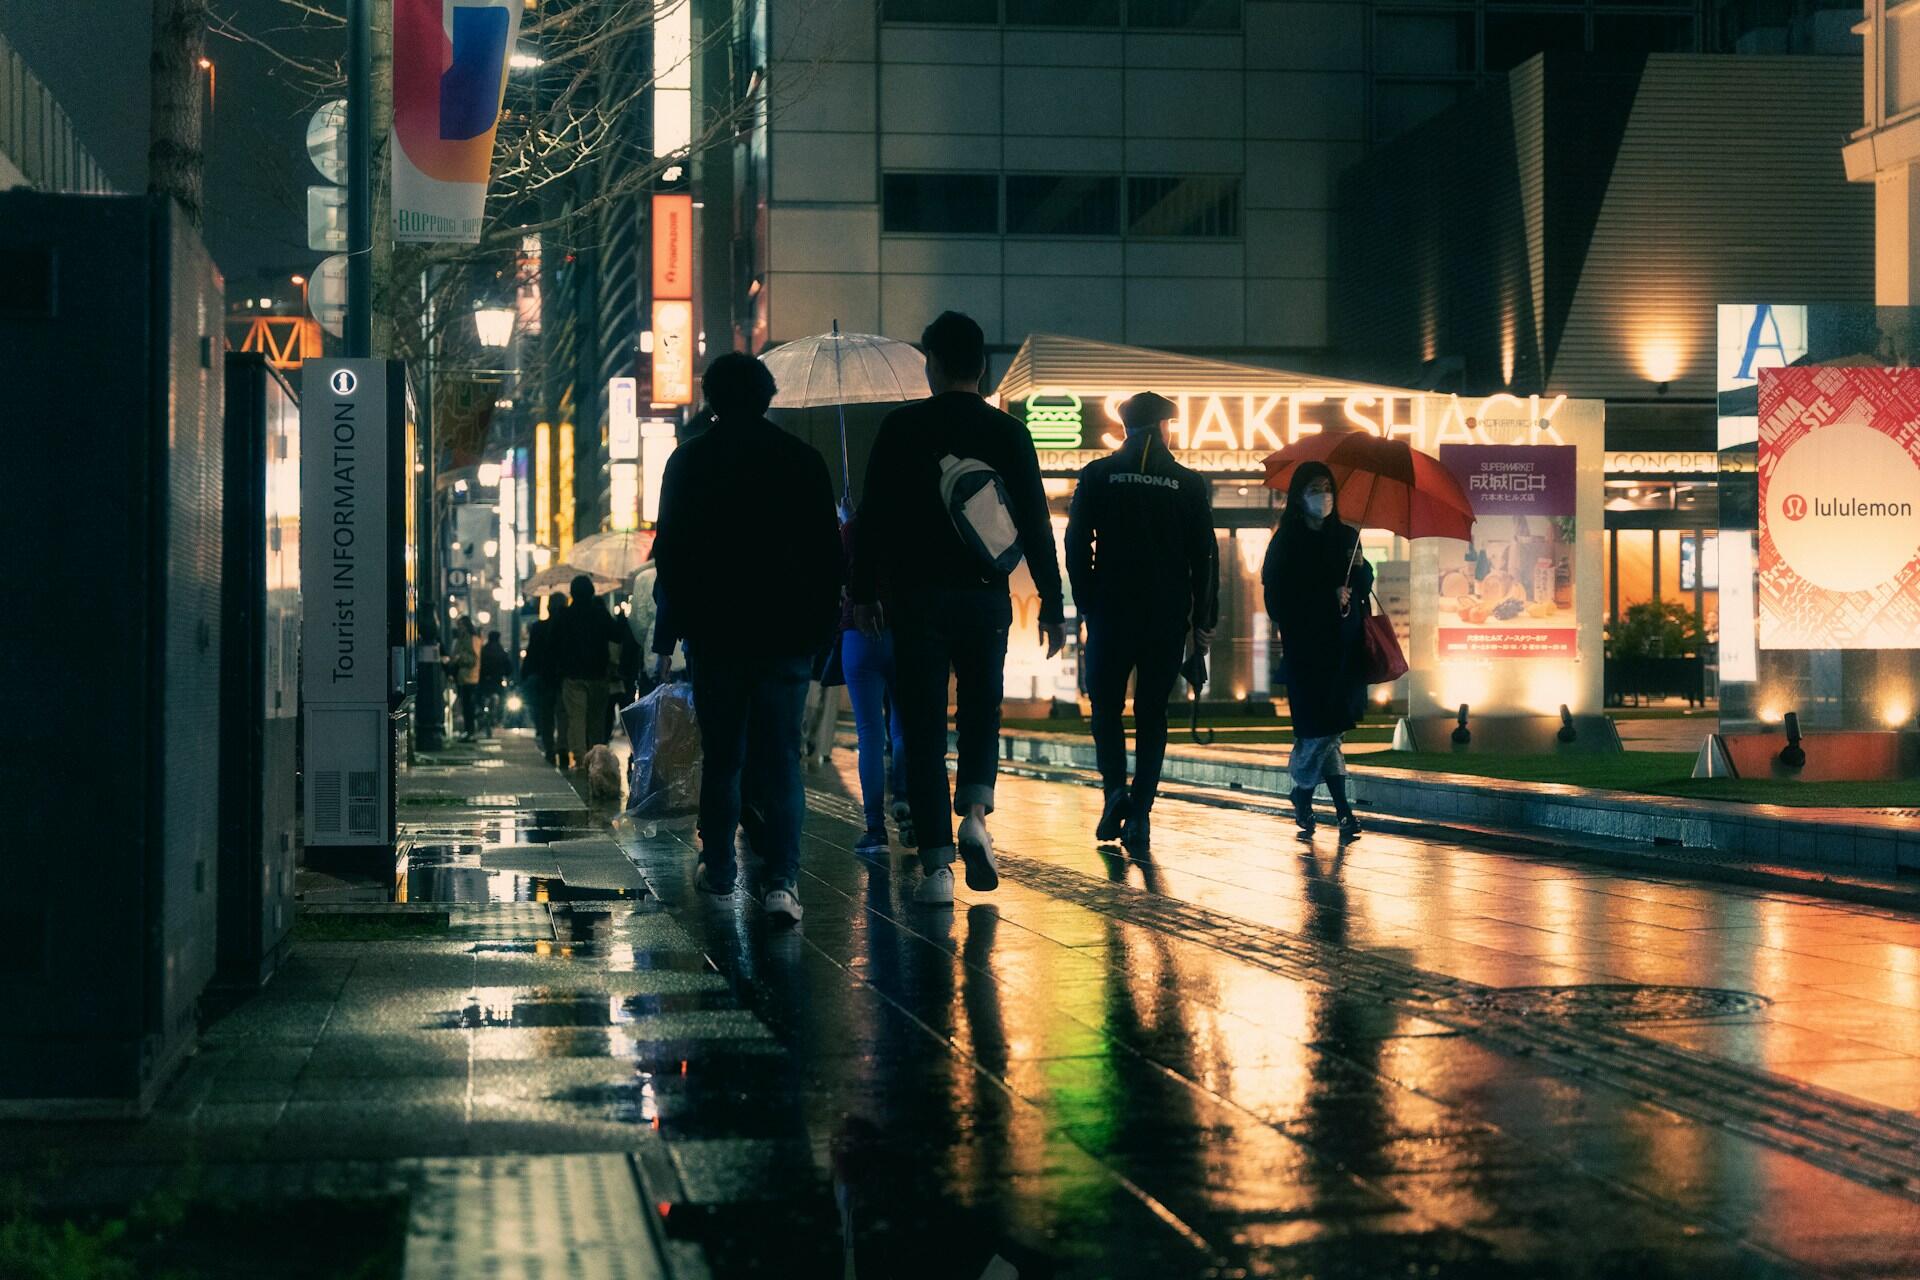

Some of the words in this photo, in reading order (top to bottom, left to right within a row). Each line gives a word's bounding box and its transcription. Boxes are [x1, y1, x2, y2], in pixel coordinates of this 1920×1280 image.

[1344, 392, 1568, 446] SHACK
[1759, 395, 1806, 446] NAMA
[1801, 394, 1836, 432] STE
[1109, 472, 1180, 490] PETRONAS
[1470, 473, 1547, 491] 成城石井
[1480, 462, 1535, 472] SUPERMARKET
[334, 402, 355, 590] INFORMATION
[1815, 496, 1912, 517] lululemon
[333, 599, 354, 684] Tourist
